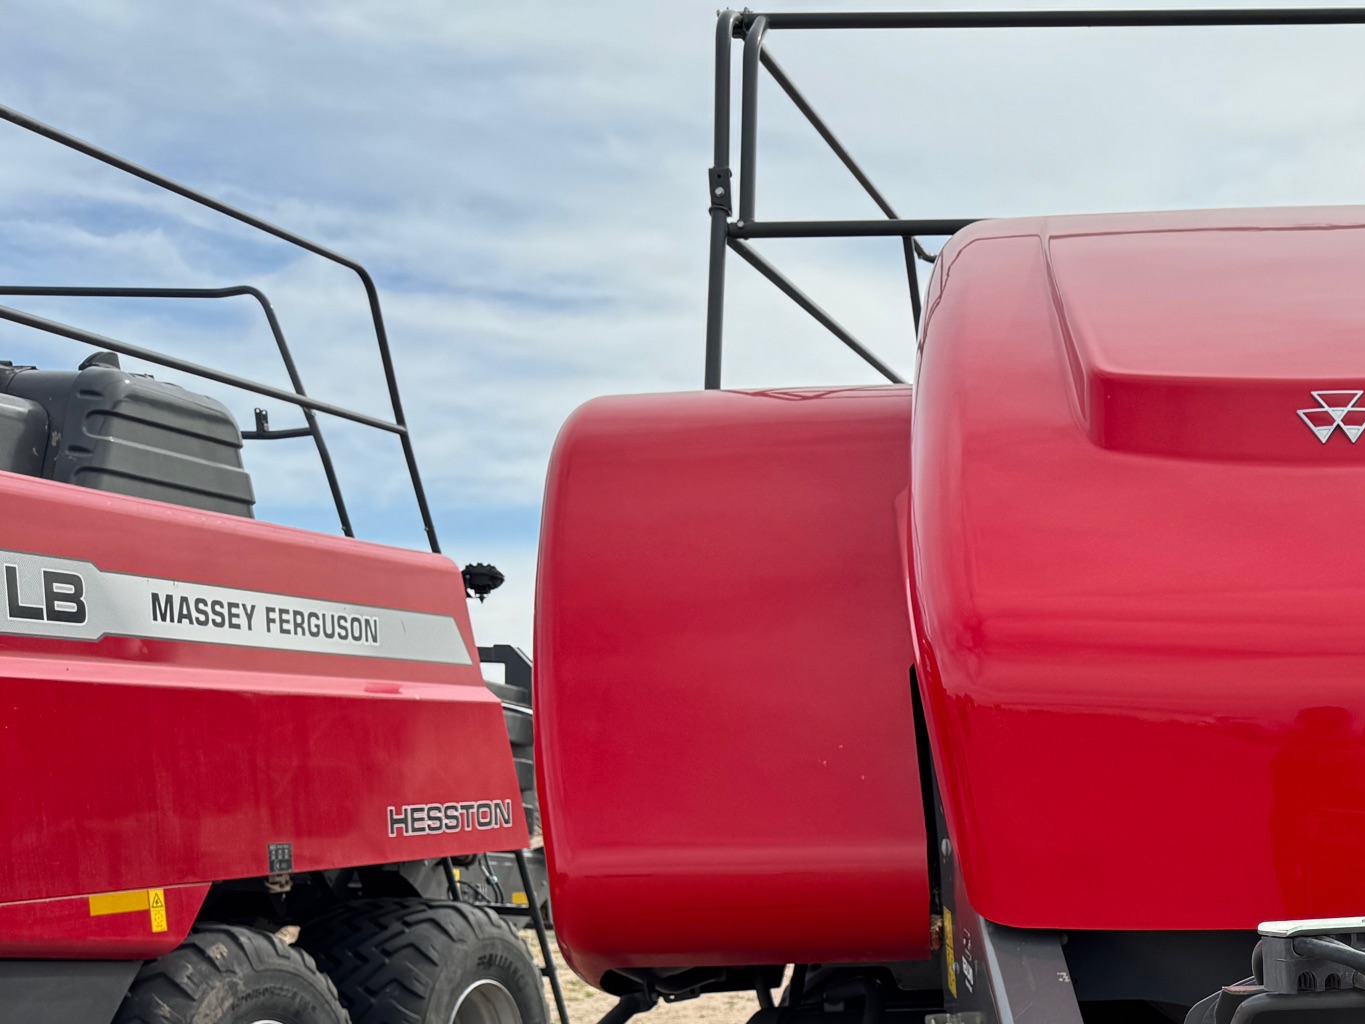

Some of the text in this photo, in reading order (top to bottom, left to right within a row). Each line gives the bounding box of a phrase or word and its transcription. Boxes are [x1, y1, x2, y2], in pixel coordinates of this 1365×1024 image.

[4, 563, 88, 626] LB
[151, 591, 379, 644] MASSEY FERGUSON
[387, 799, 512, 838] HESSTON
